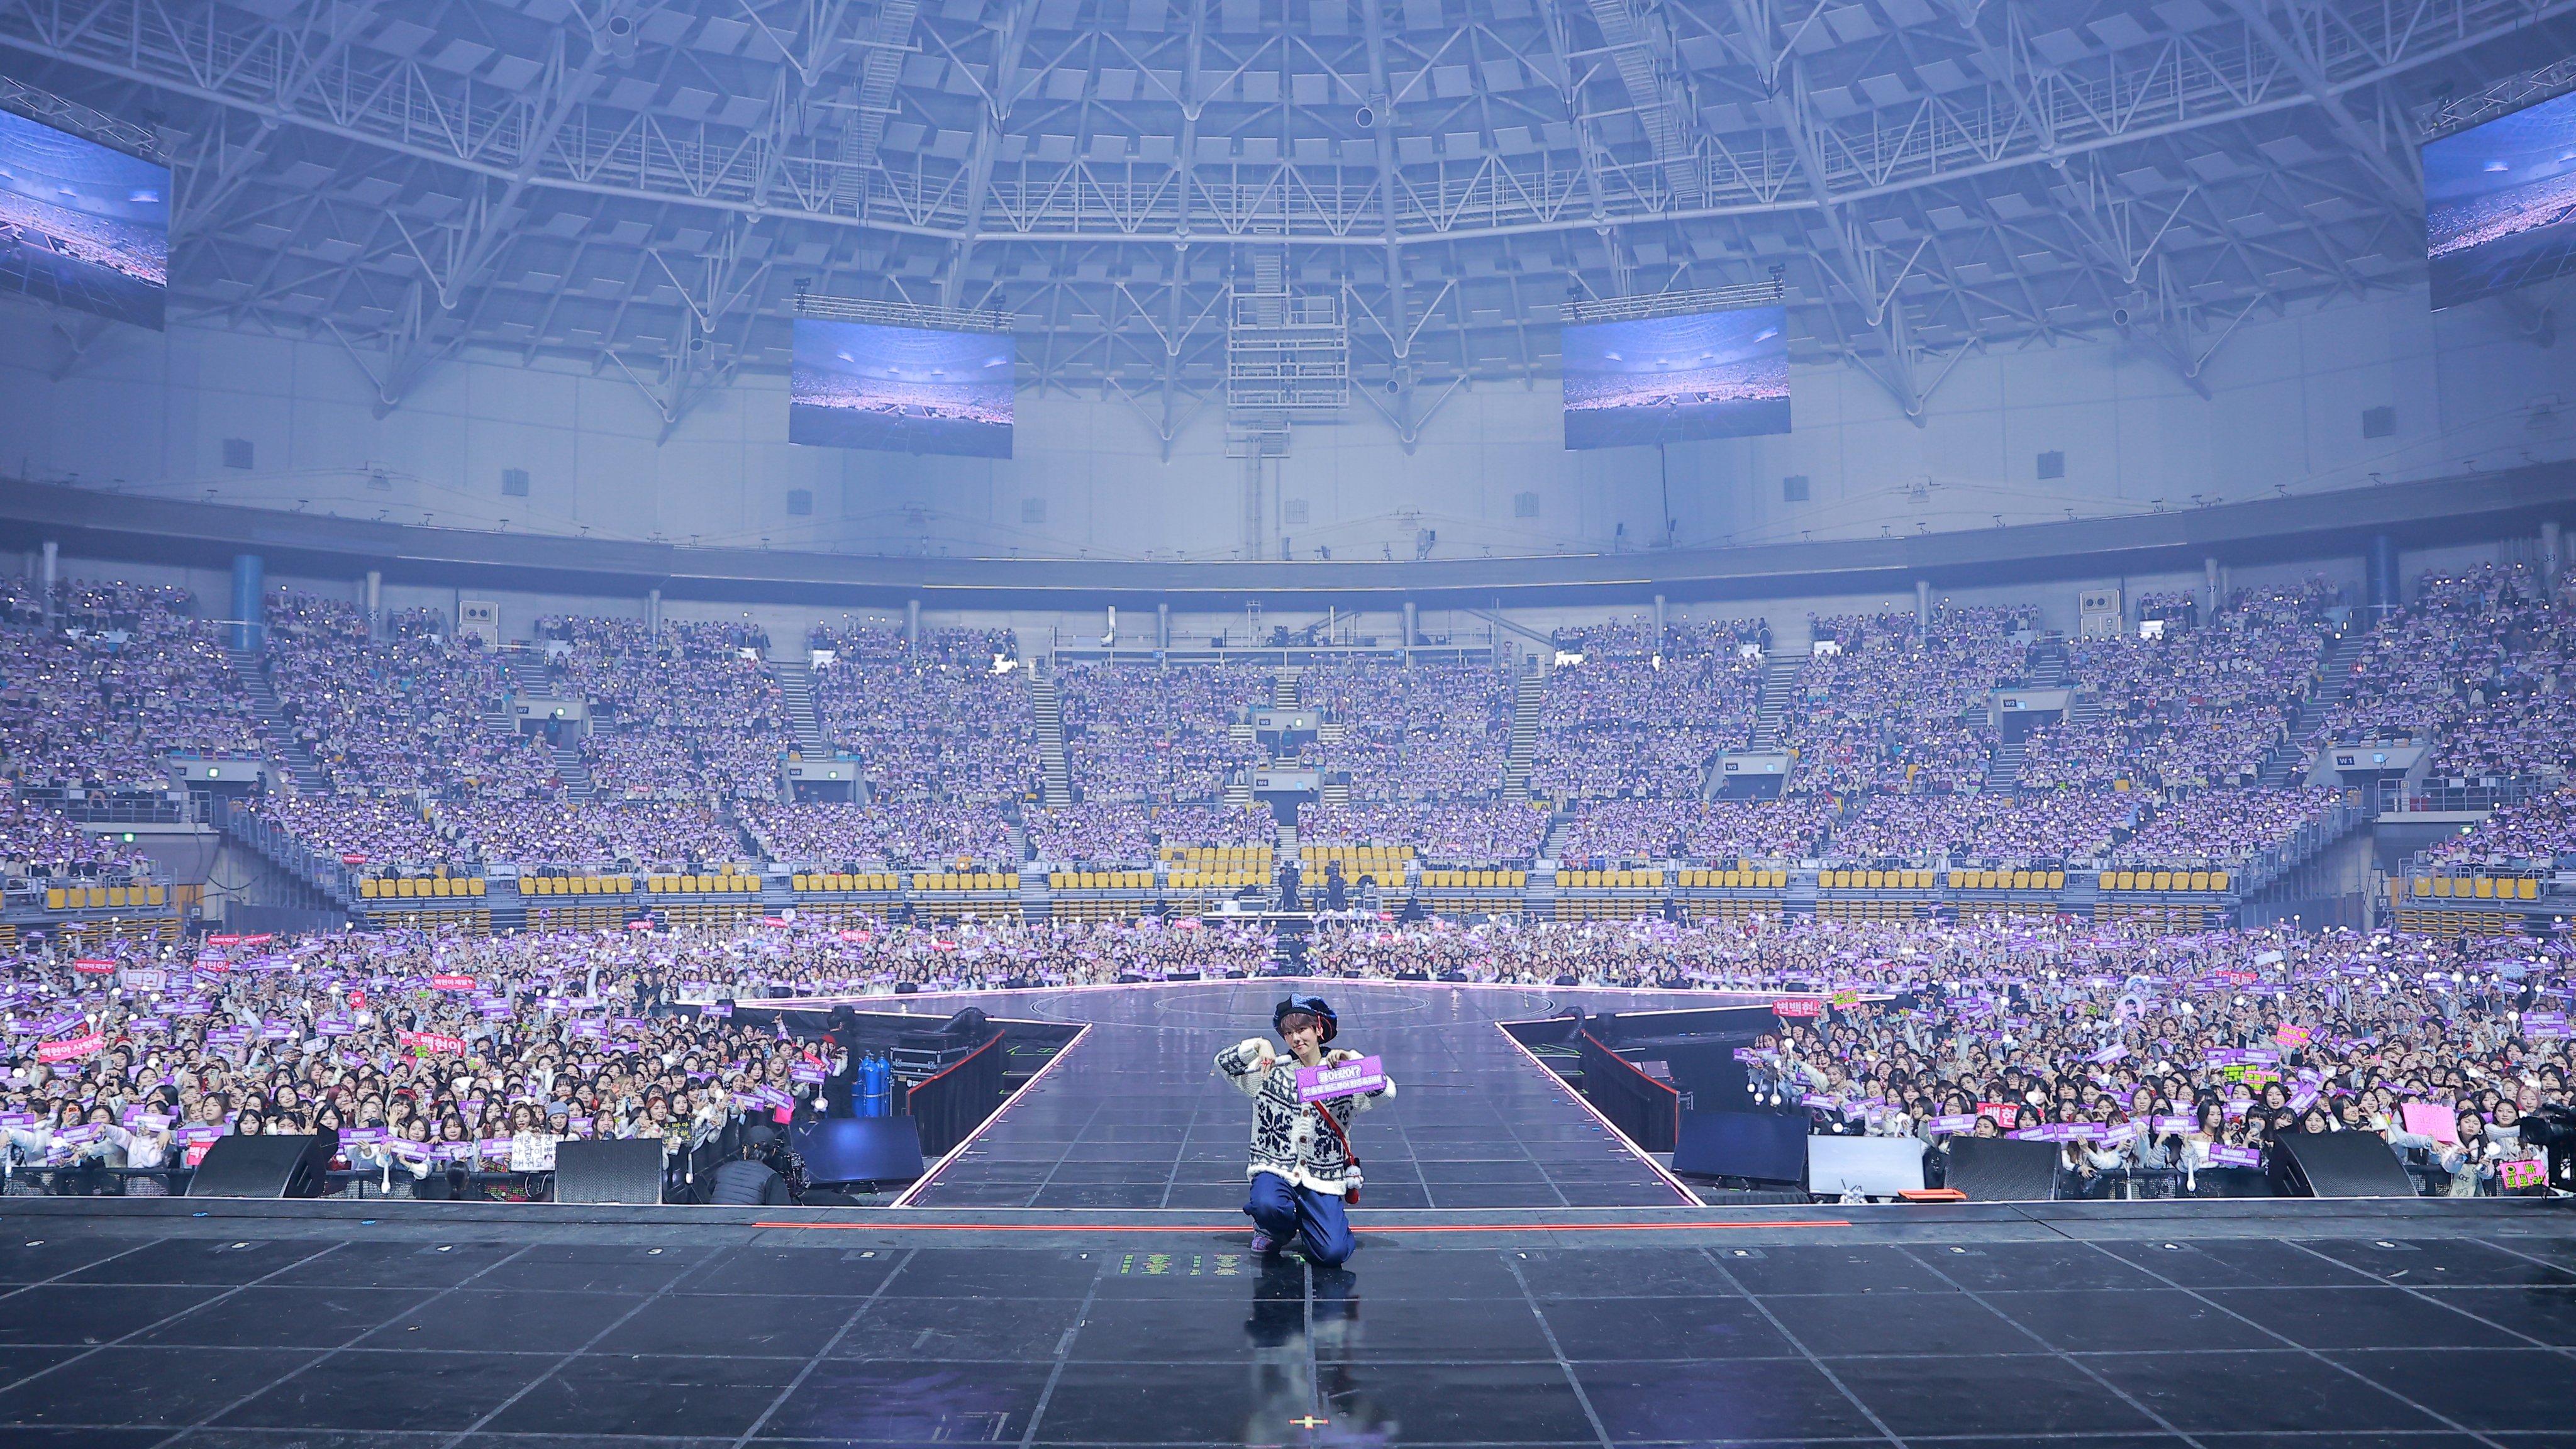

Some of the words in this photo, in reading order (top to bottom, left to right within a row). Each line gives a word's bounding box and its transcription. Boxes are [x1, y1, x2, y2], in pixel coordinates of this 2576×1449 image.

[1777, 1001, 1814, 1014] 변백현
[2279, 1026, 2298, 1036] BAEK
[2277, 1034, 2290, 1043] Kiss
[40, 1044, 73, 1057] 백현아
